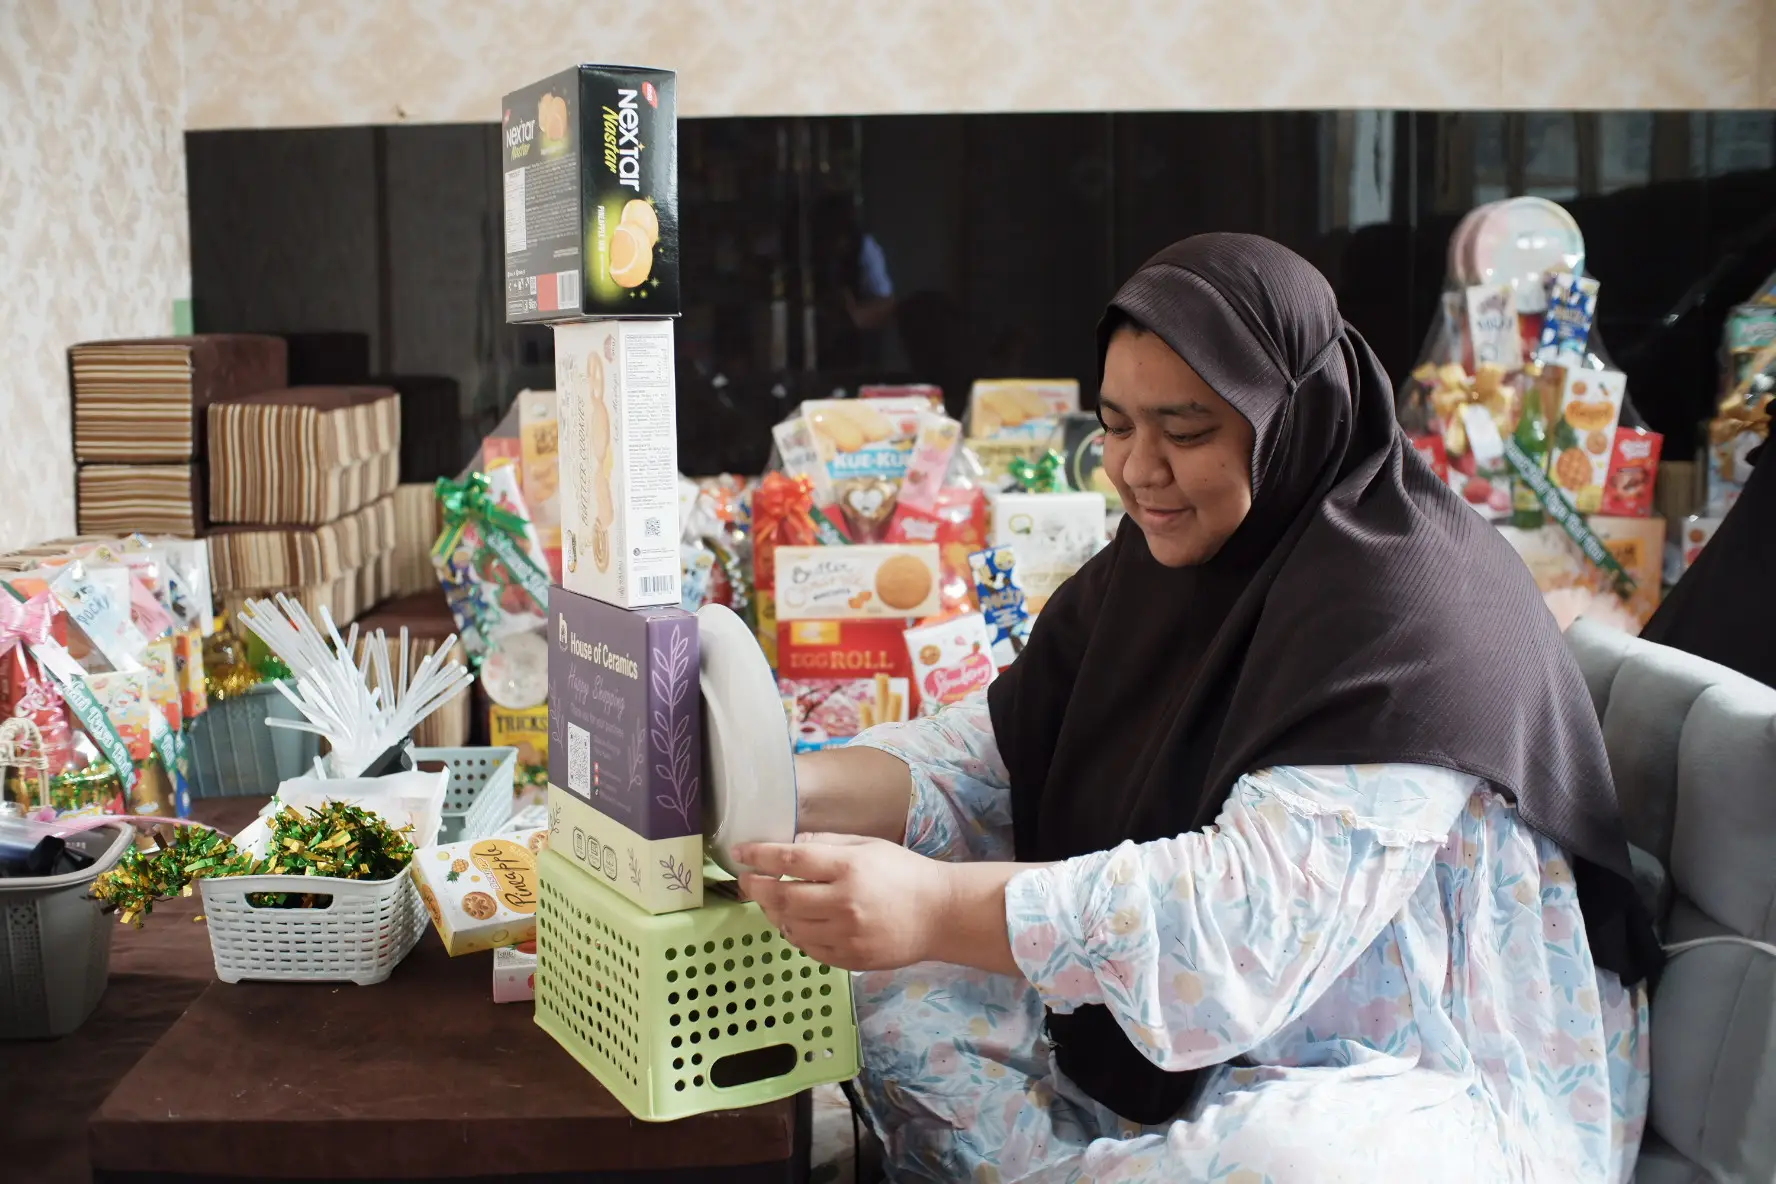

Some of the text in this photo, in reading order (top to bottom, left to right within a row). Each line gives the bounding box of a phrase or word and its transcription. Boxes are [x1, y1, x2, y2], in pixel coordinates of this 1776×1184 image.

[602, 105, 617, 174] Nastar
[576, 396, 586, 461] COOKIES
[570, 631, 638, 680] House of Ceramics
[790, 650, 895, 669] EGG ROLL
[568, 661, 625, 722] Happy Shopping
[475, 843, 536, 908] Pineapple
